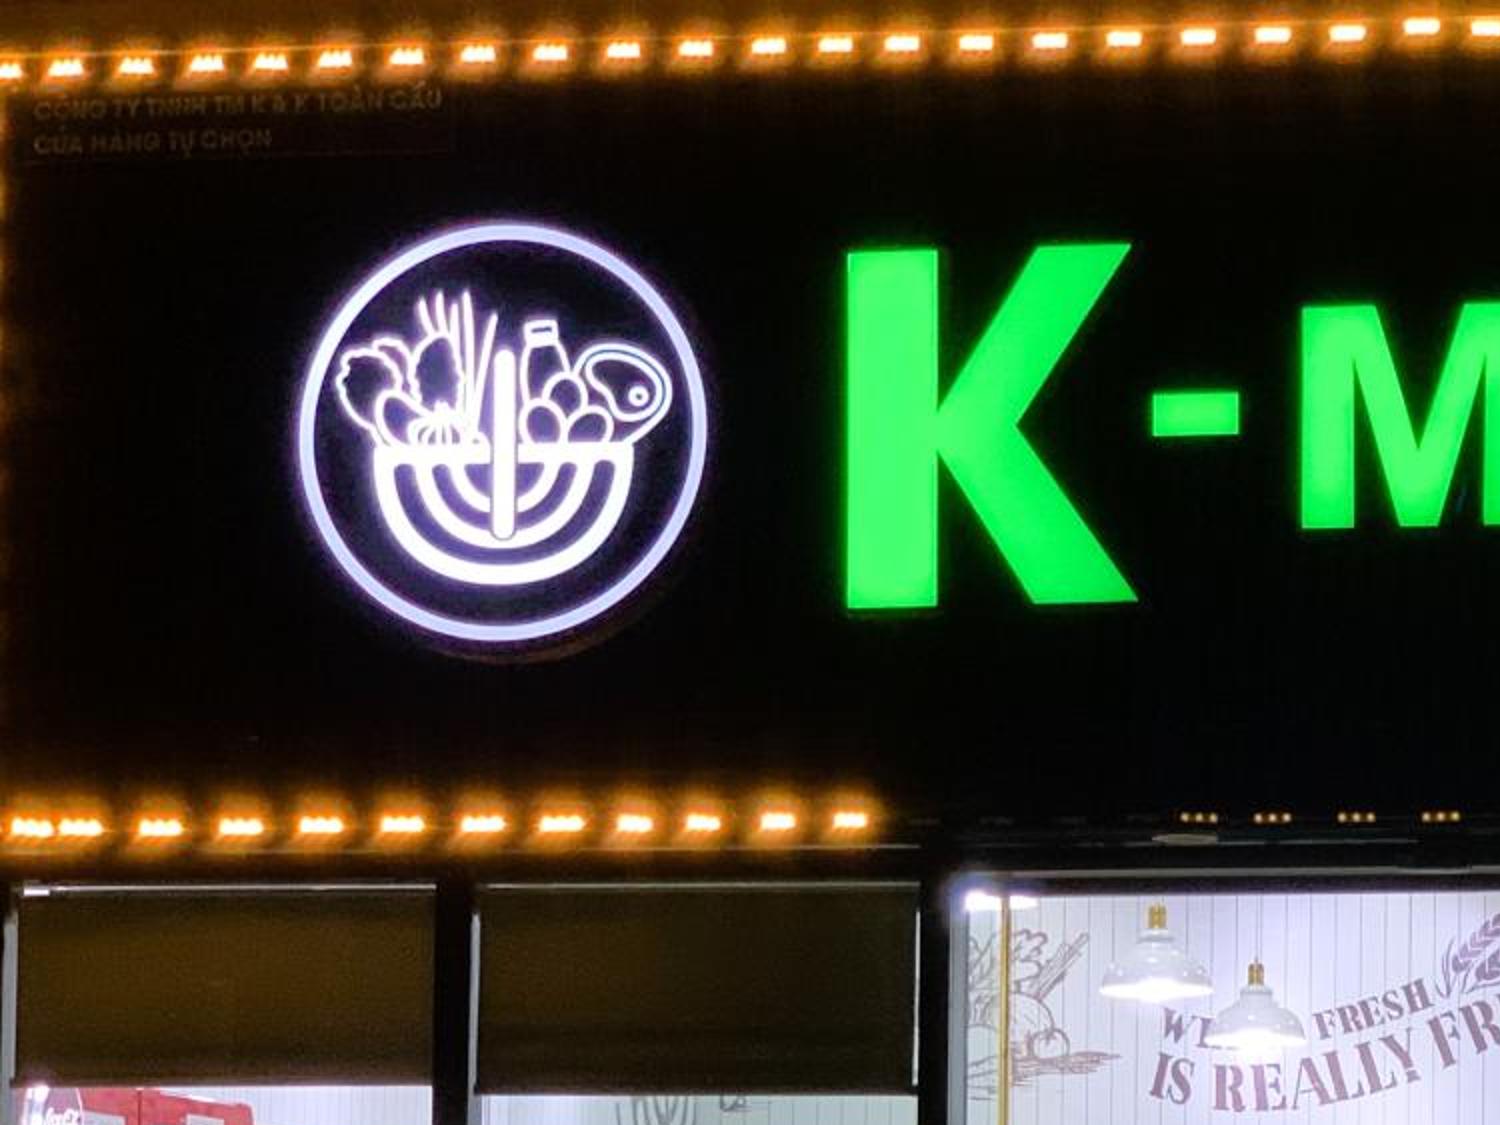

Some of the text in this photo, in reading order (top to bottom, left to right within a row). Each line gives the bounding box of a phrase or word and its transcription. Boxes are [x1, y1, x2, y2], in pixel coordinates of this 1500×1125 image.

[1312, 977, 1435, 1041] FRESH
[1149, 1051, 1196, 1106] IS
[1212, 1029, 1423, 1113] REALLY
